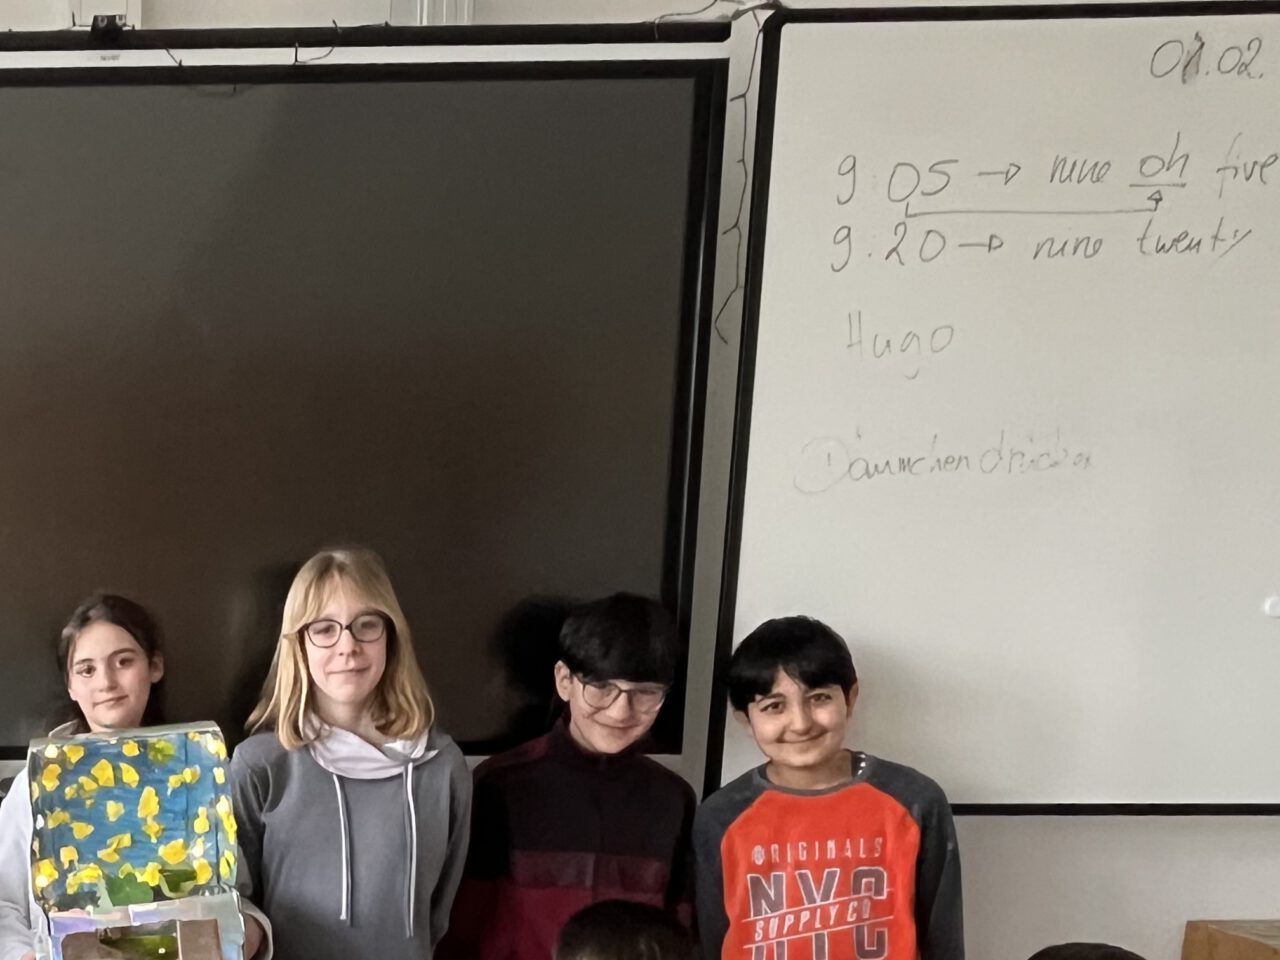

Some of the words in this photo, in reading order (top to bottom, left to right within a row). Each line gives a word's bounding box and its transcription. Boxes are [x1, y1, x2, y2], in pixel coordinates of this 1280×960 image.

[1049, 154, 1112, 184] nine
[1139, 131, 1190, 178] oh
[1215, 132, 1280, 199] five
[846, 309, 954, 380] Hugo
[752, 837, 883, 865] ORIGINALS
[754, 904, 840, 942] SUPPLY
